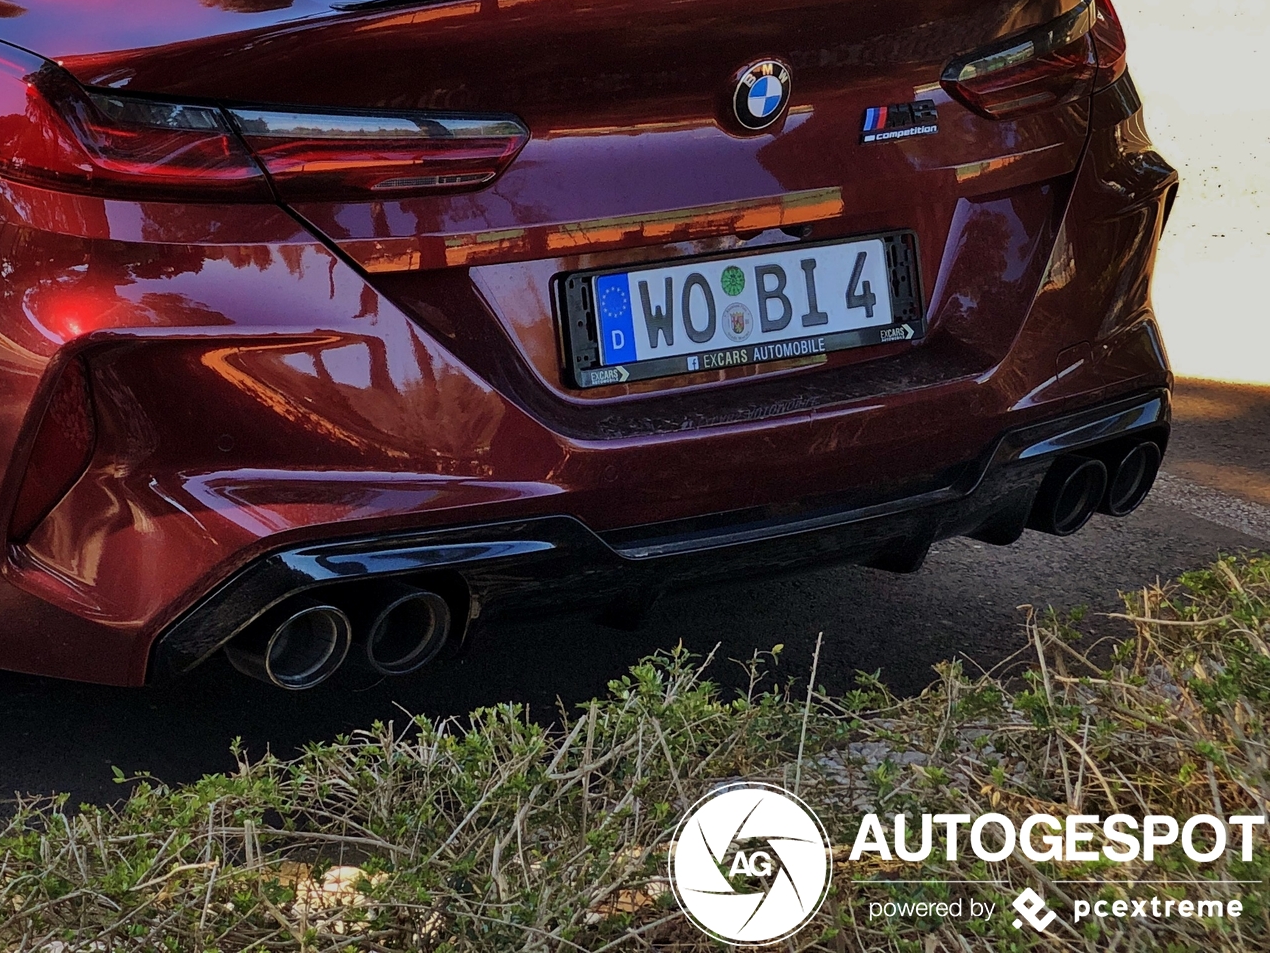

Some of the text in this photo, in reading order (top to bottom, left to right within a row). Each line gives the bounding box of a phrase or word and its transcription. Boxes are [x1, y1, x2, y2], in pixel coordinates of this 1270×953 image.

[743, 64, 790, 88] BMW
[876, 125, 937, 140] competition
[638, 252, 876, 348] WO BI 4
[612, 330, 625, 350] D
[880, 327, 905, 339] EXCARS
[703, 350, 748, 368] EXCARS
[753, 338, 826, 361] AUTOMOBILE
[591, 369, 618, 381] EXCARS
